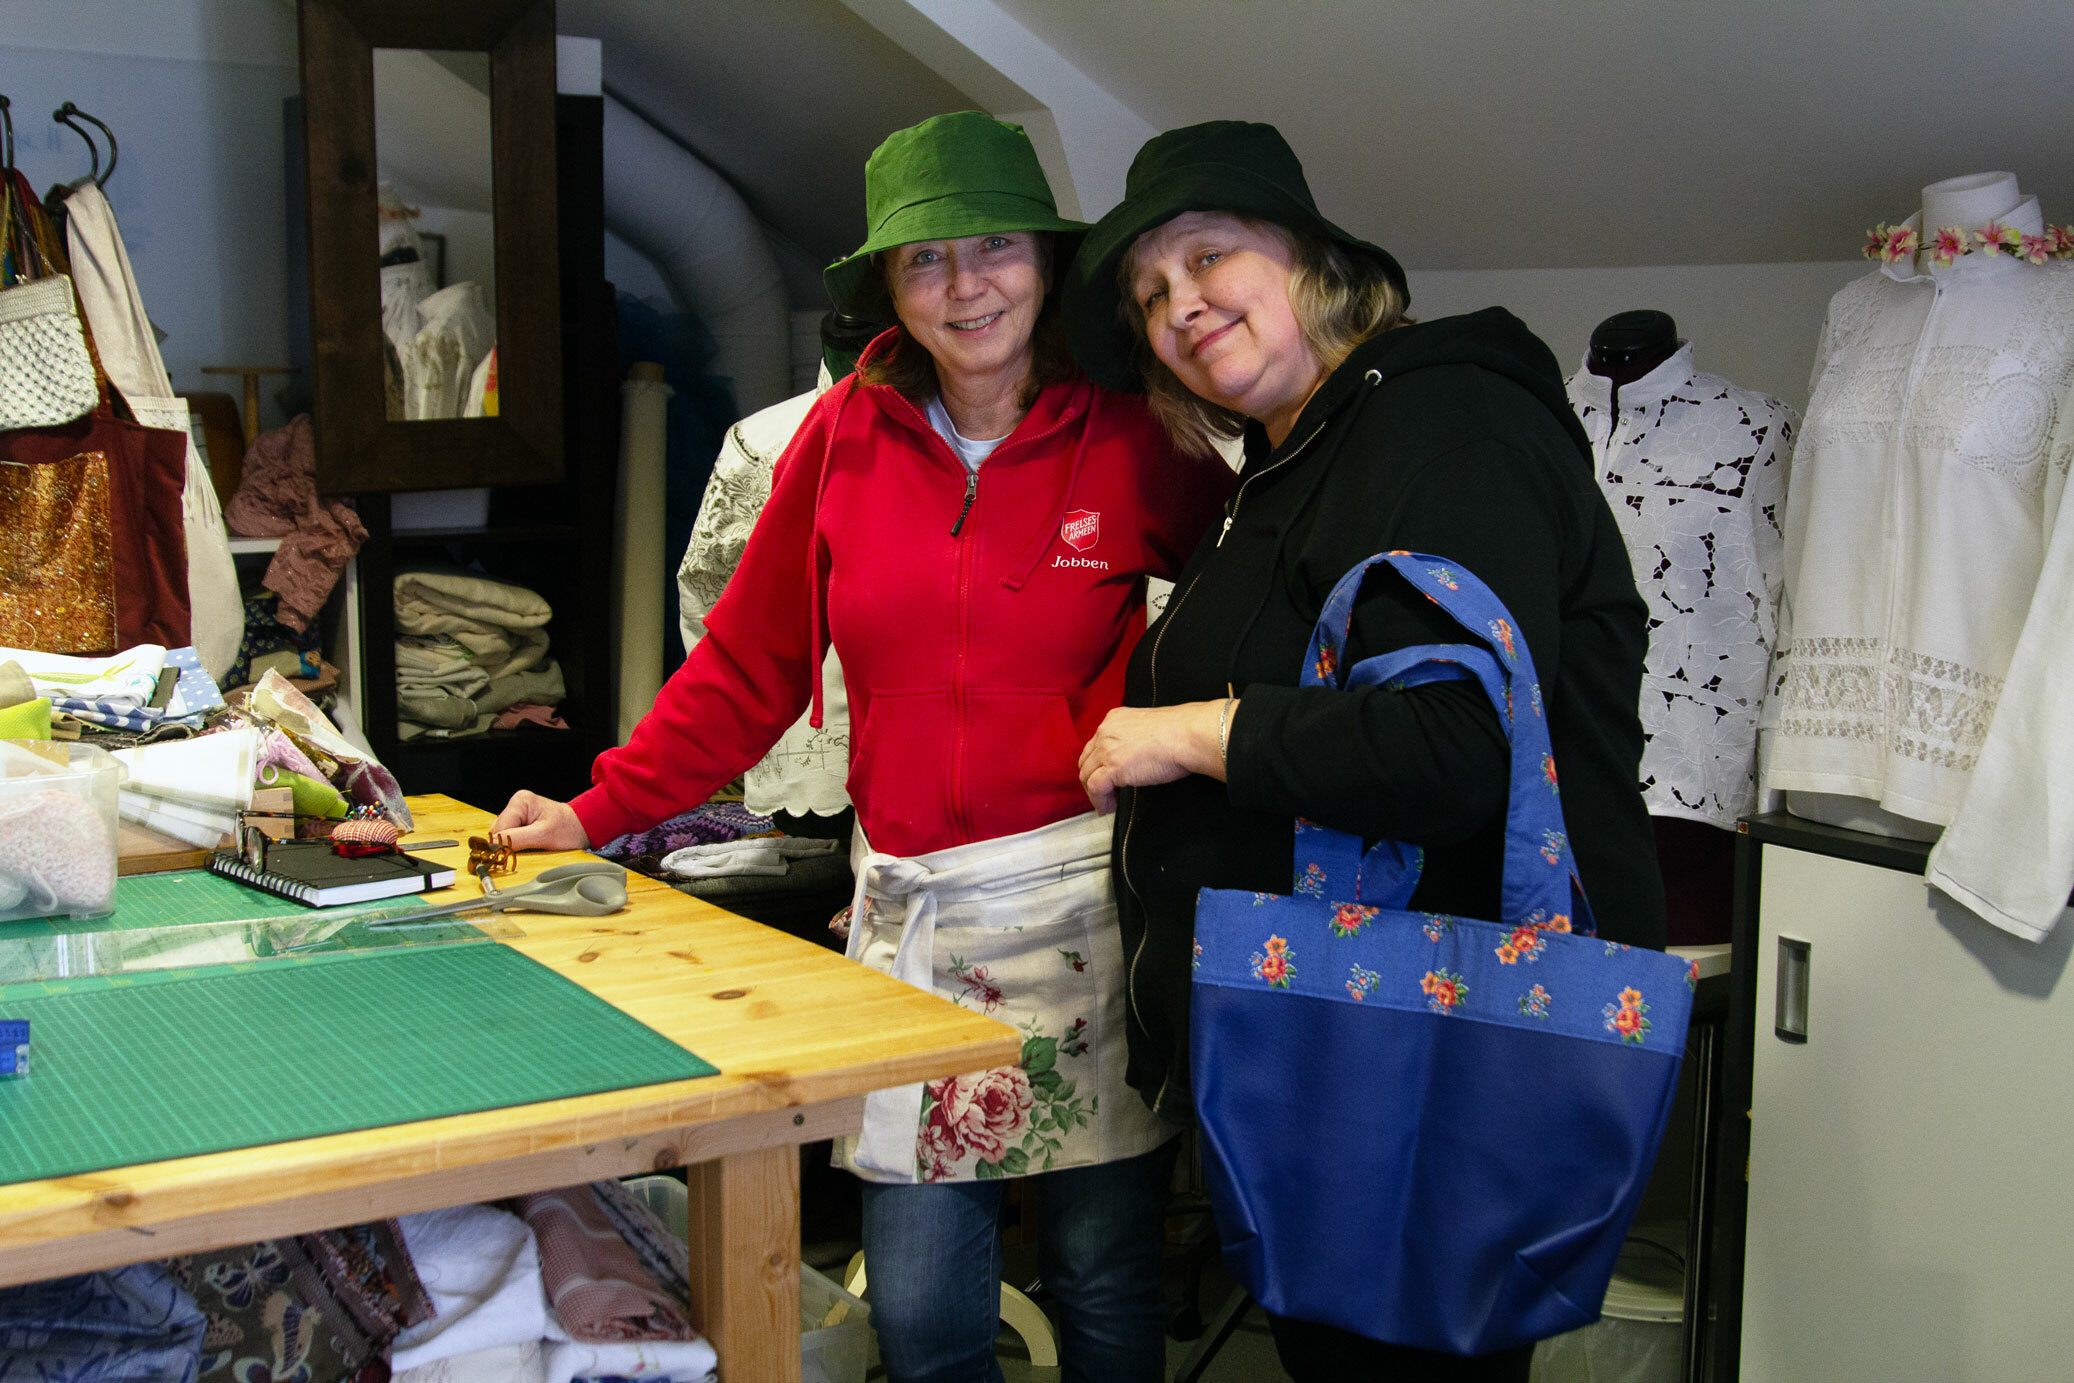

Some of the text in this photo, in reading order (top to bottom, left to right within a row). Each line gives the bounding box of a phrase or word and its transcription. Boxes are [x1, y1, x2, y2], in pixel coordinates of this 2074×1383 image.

[1064, 514, 1097, 534] FRELSES
[1068, 525, 1096, 541] ARMEEN
[1051, 555, 1109, 570] Jobben
